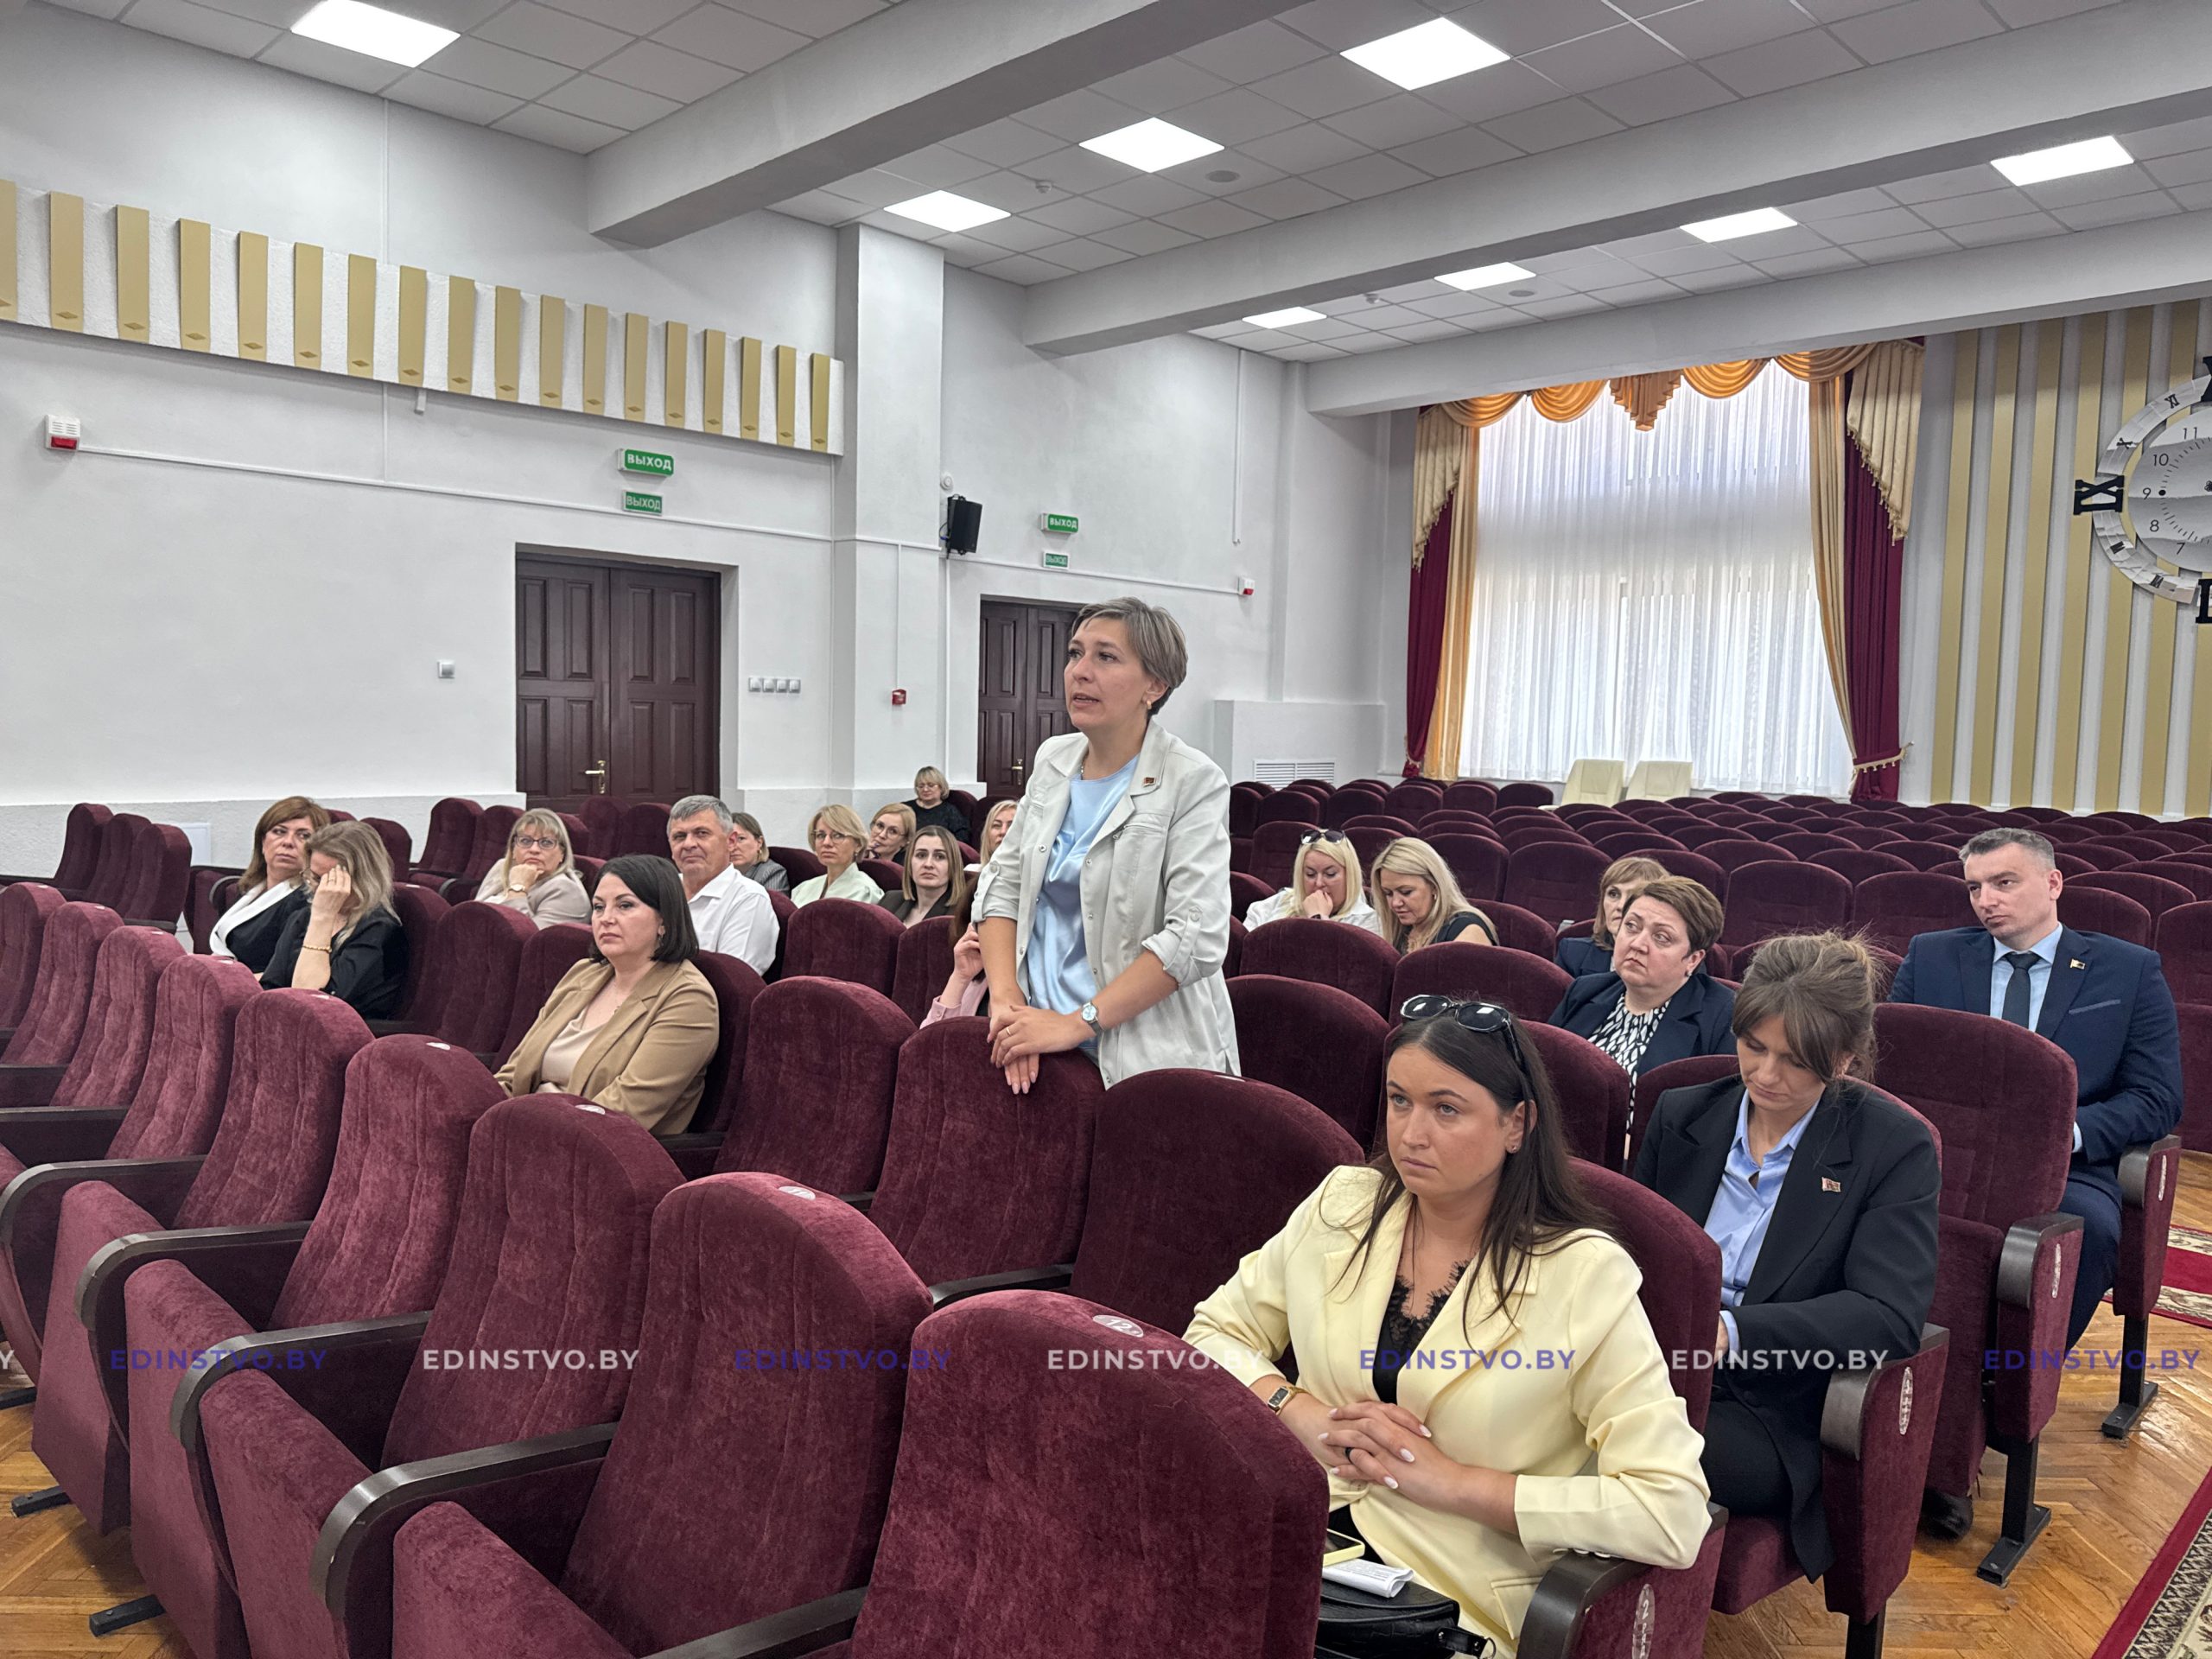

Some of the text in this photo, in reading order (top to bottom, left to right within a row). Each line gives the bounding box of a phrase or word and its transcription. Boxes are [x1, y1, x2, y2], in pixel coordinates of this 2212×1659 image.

[2183, 427, 2197, 440] 11
[627, 454, 671, 471] ВЫХОД
[2153, 453, 2169, 467] 10
[2142, 487, 2152, 500] 9
[626, 495, 660, 511] ВЫХОД
[1050, 518, 1077, 529] ВЫХОД
[2150, 519, 2159, 532] 8
[2177, 542, 2185, 555] 7
[1106, 1319, 1132, 1332] 12
[1642, 1599, 1649, 1620] 2
